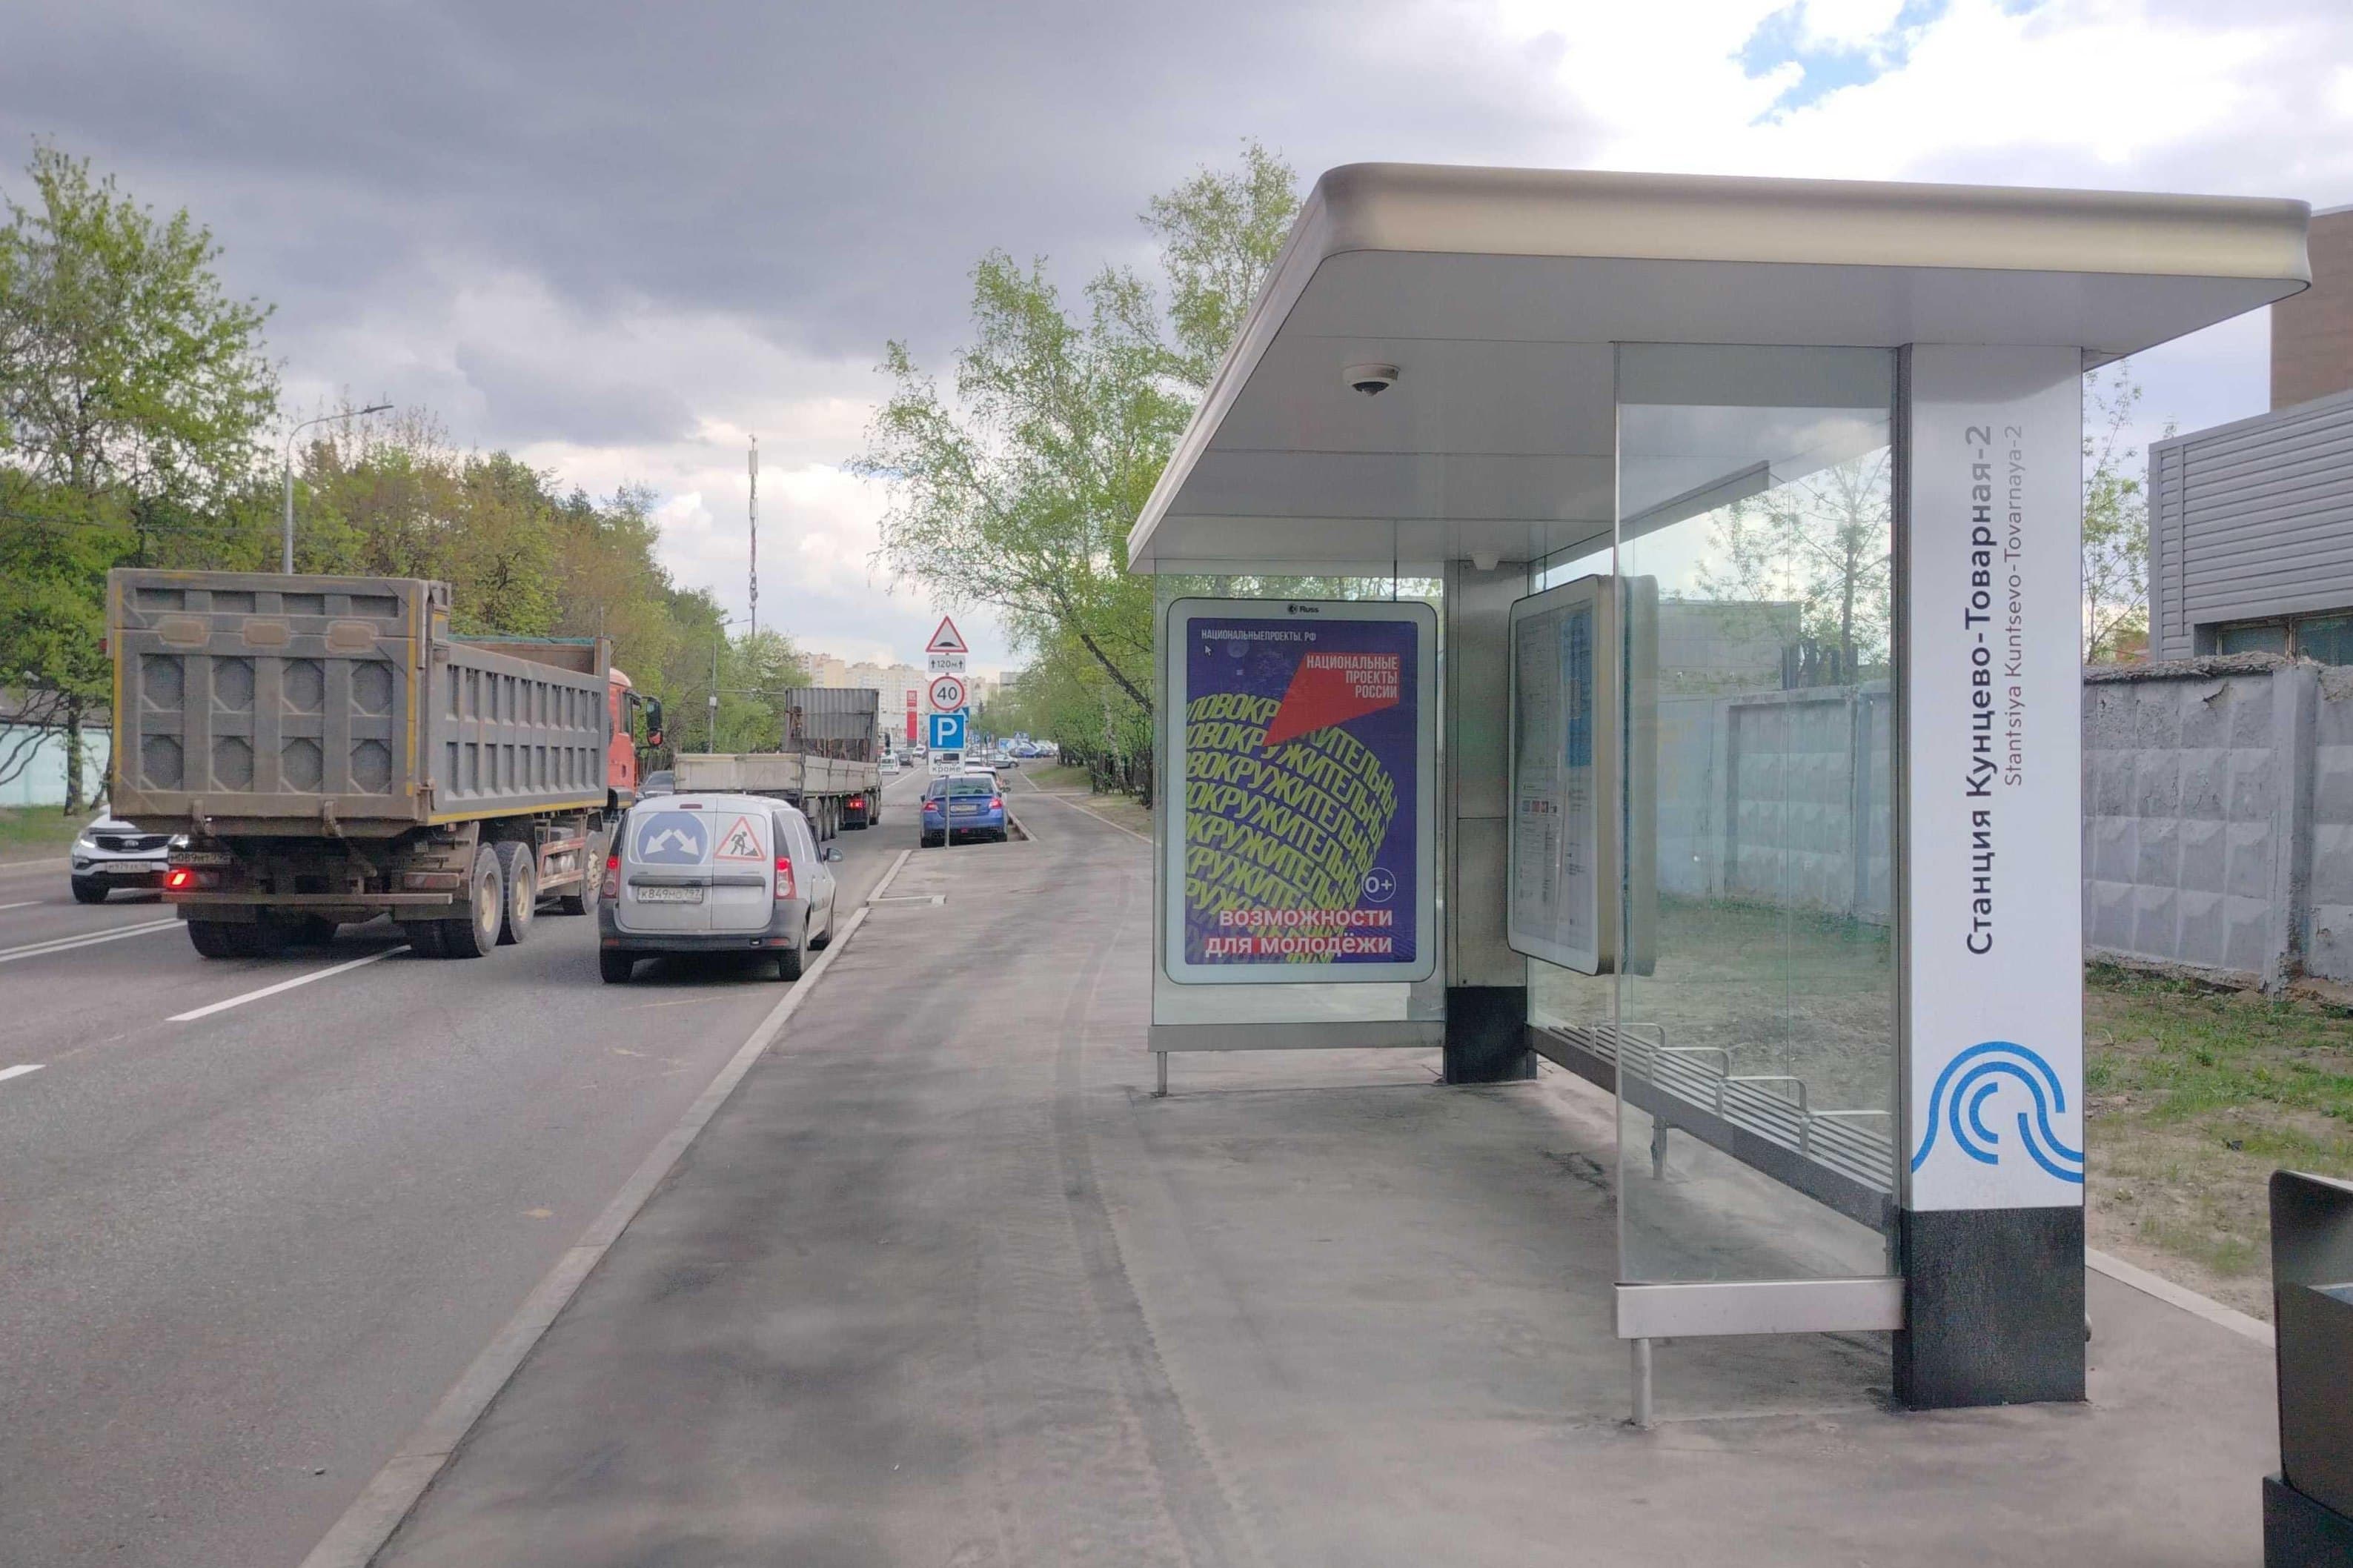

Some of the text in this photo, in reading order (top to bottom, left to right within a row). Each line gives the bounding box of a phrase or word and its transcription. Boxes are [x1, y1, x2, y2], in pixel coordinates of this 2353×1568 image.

[1298, 605, 1319, 614] Russ
[2004, 425, 2025, 786] Stantsiya Kuntsevo-Tovarnaya-2
[1306, 654, 1398, 671] НАЦИОНАЛЬНЫЕ
[1345, 670, 1398, 685] ПРОЕКТЫ
[937, 686, 958, 700] 40
[1355, 685, 1398, 699] РОССИИ
[1965, 425, 1998, 955] Станция Кунцево-Товарная-2
[937, 717, 958, 746] P
[1364, 877, 1393, 894] 0+
